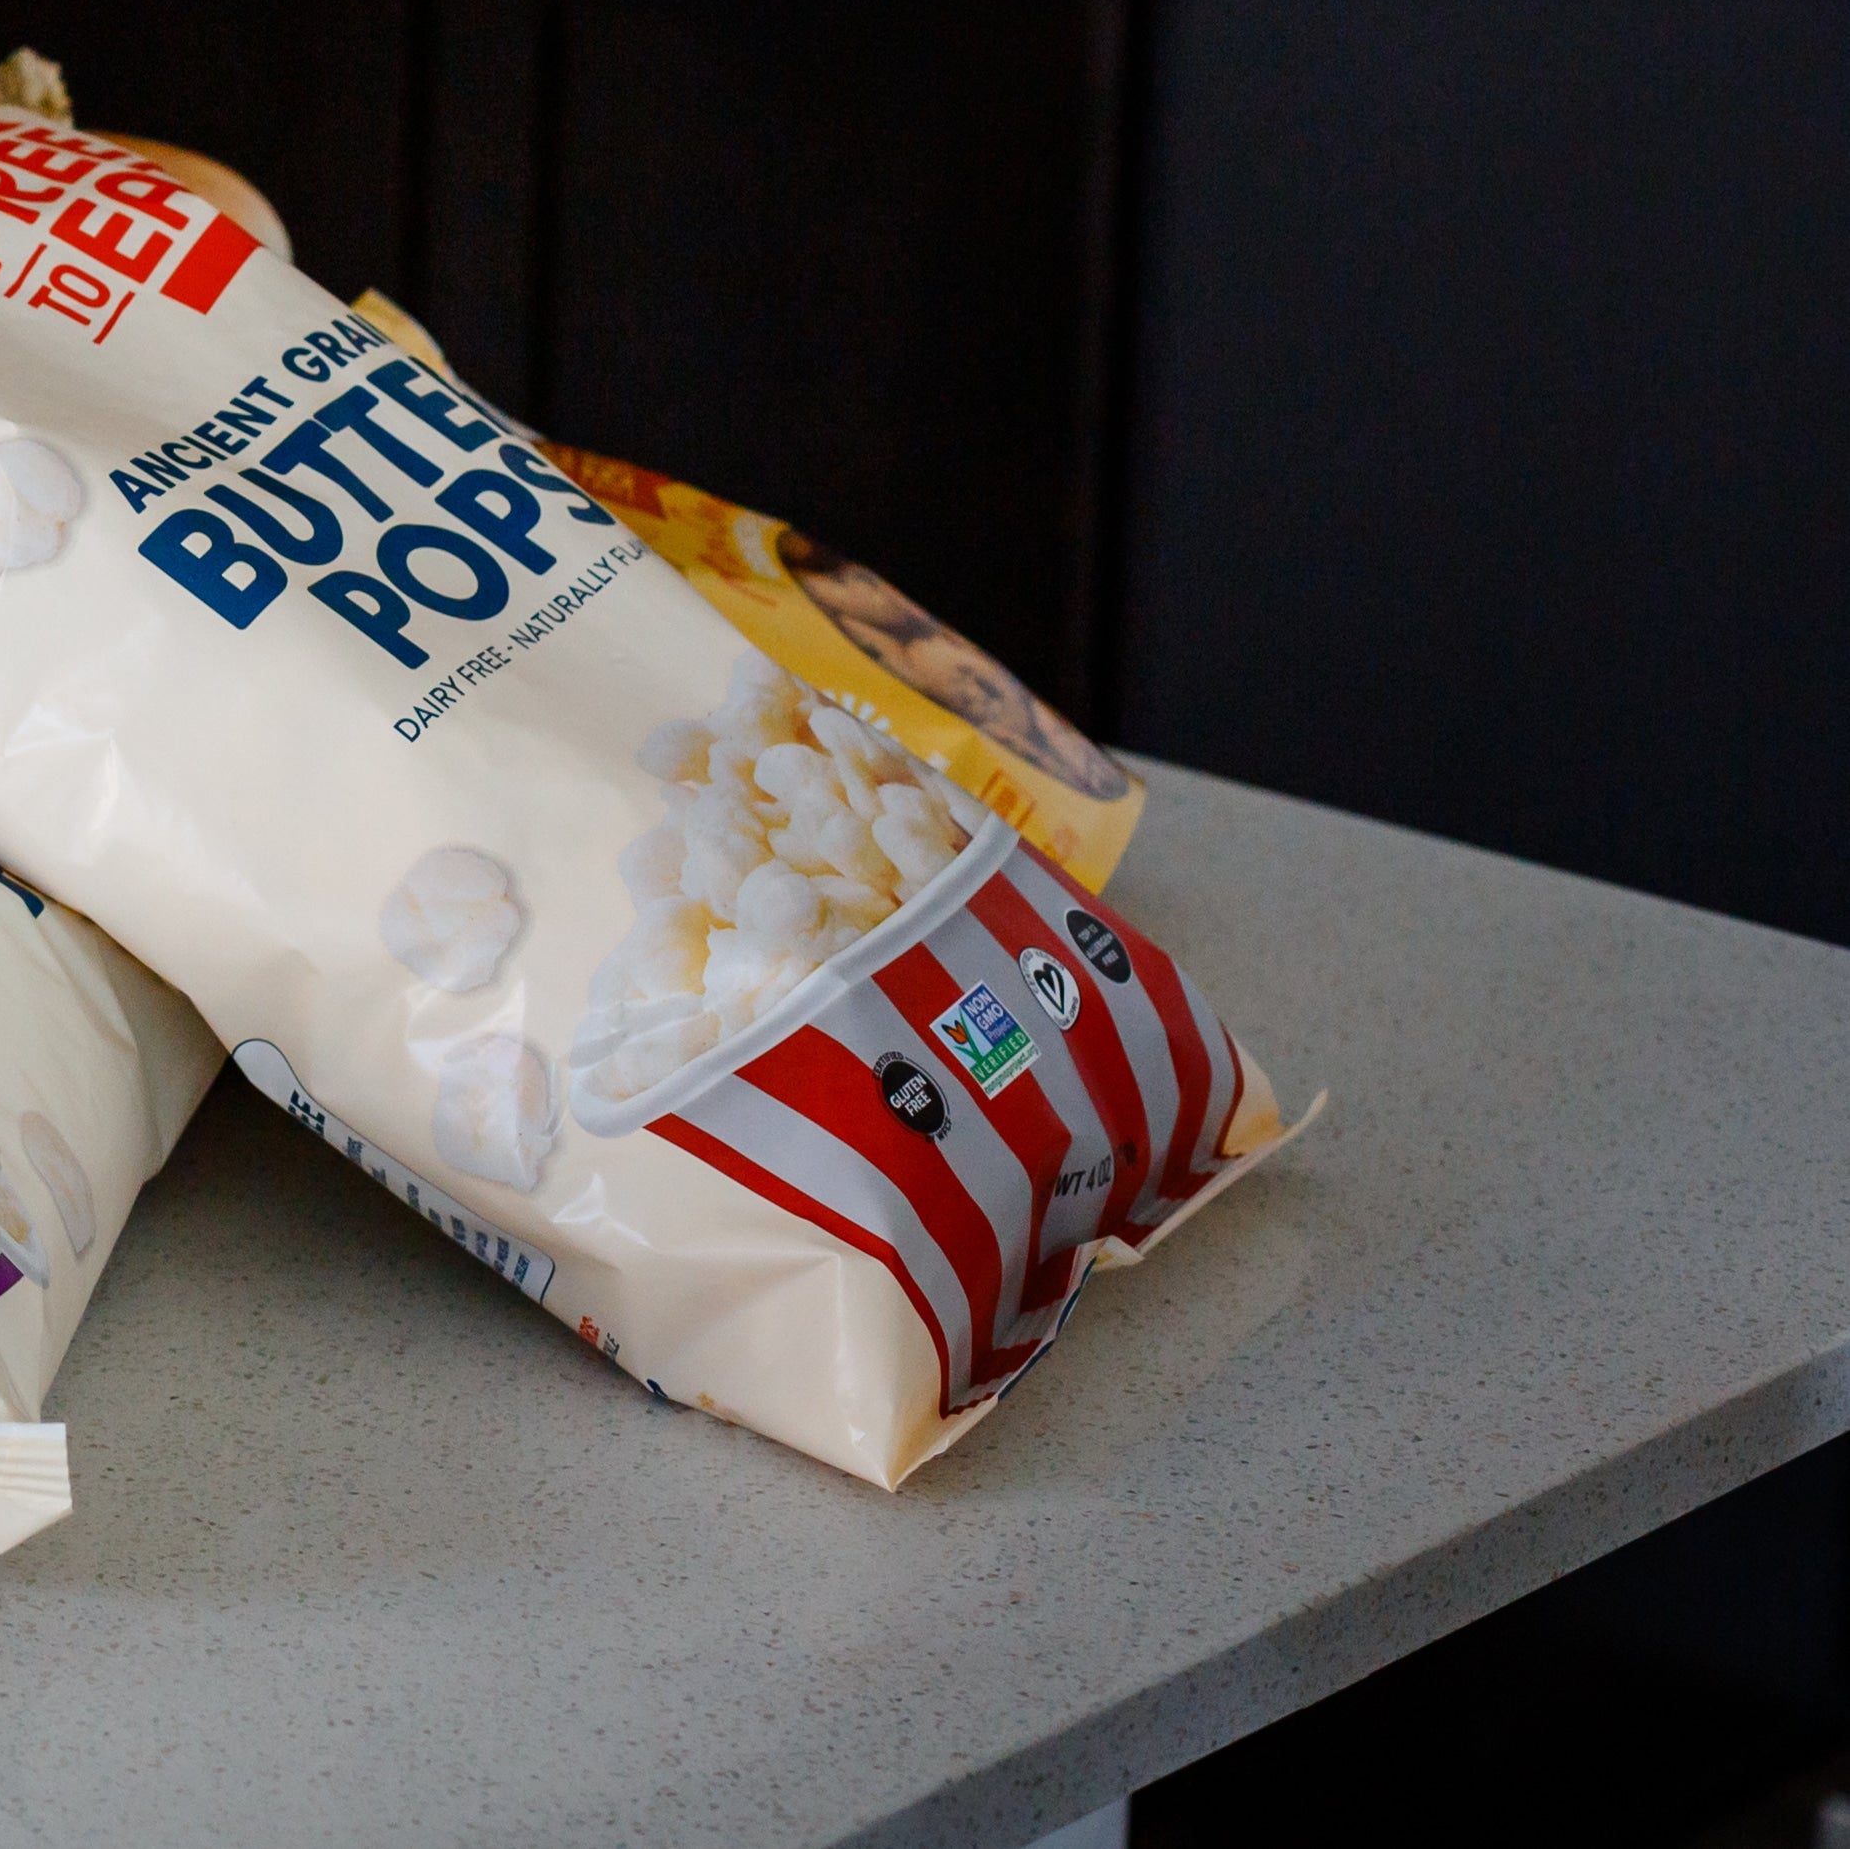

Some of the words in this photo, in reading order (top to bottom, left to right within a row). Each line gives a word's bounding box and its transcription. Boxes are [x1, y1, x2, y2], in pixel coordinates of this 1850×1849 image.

[28, 262, 112, 326] TO
[108, 375, 295, 515] ANCIENT
[137, 355, 526, 630] BUTTE
[307, 442, 617, 670] POPS
[392, 674, 467, 743] DAIRY
[456, 645, 512, 687] FREE
[507, 556, 619, 652] NATURALLY
[964, 989, 993, 1018] NON
[975, 1004, 1004, 1031] GMO
[975, 1031, 1026, 1079] VERIFIED
[889, 1073, 927, 1109] GLUTEN
[904, 1089, 932, 1117] FREE
[1054, 1170, 1087, 1197] WT
